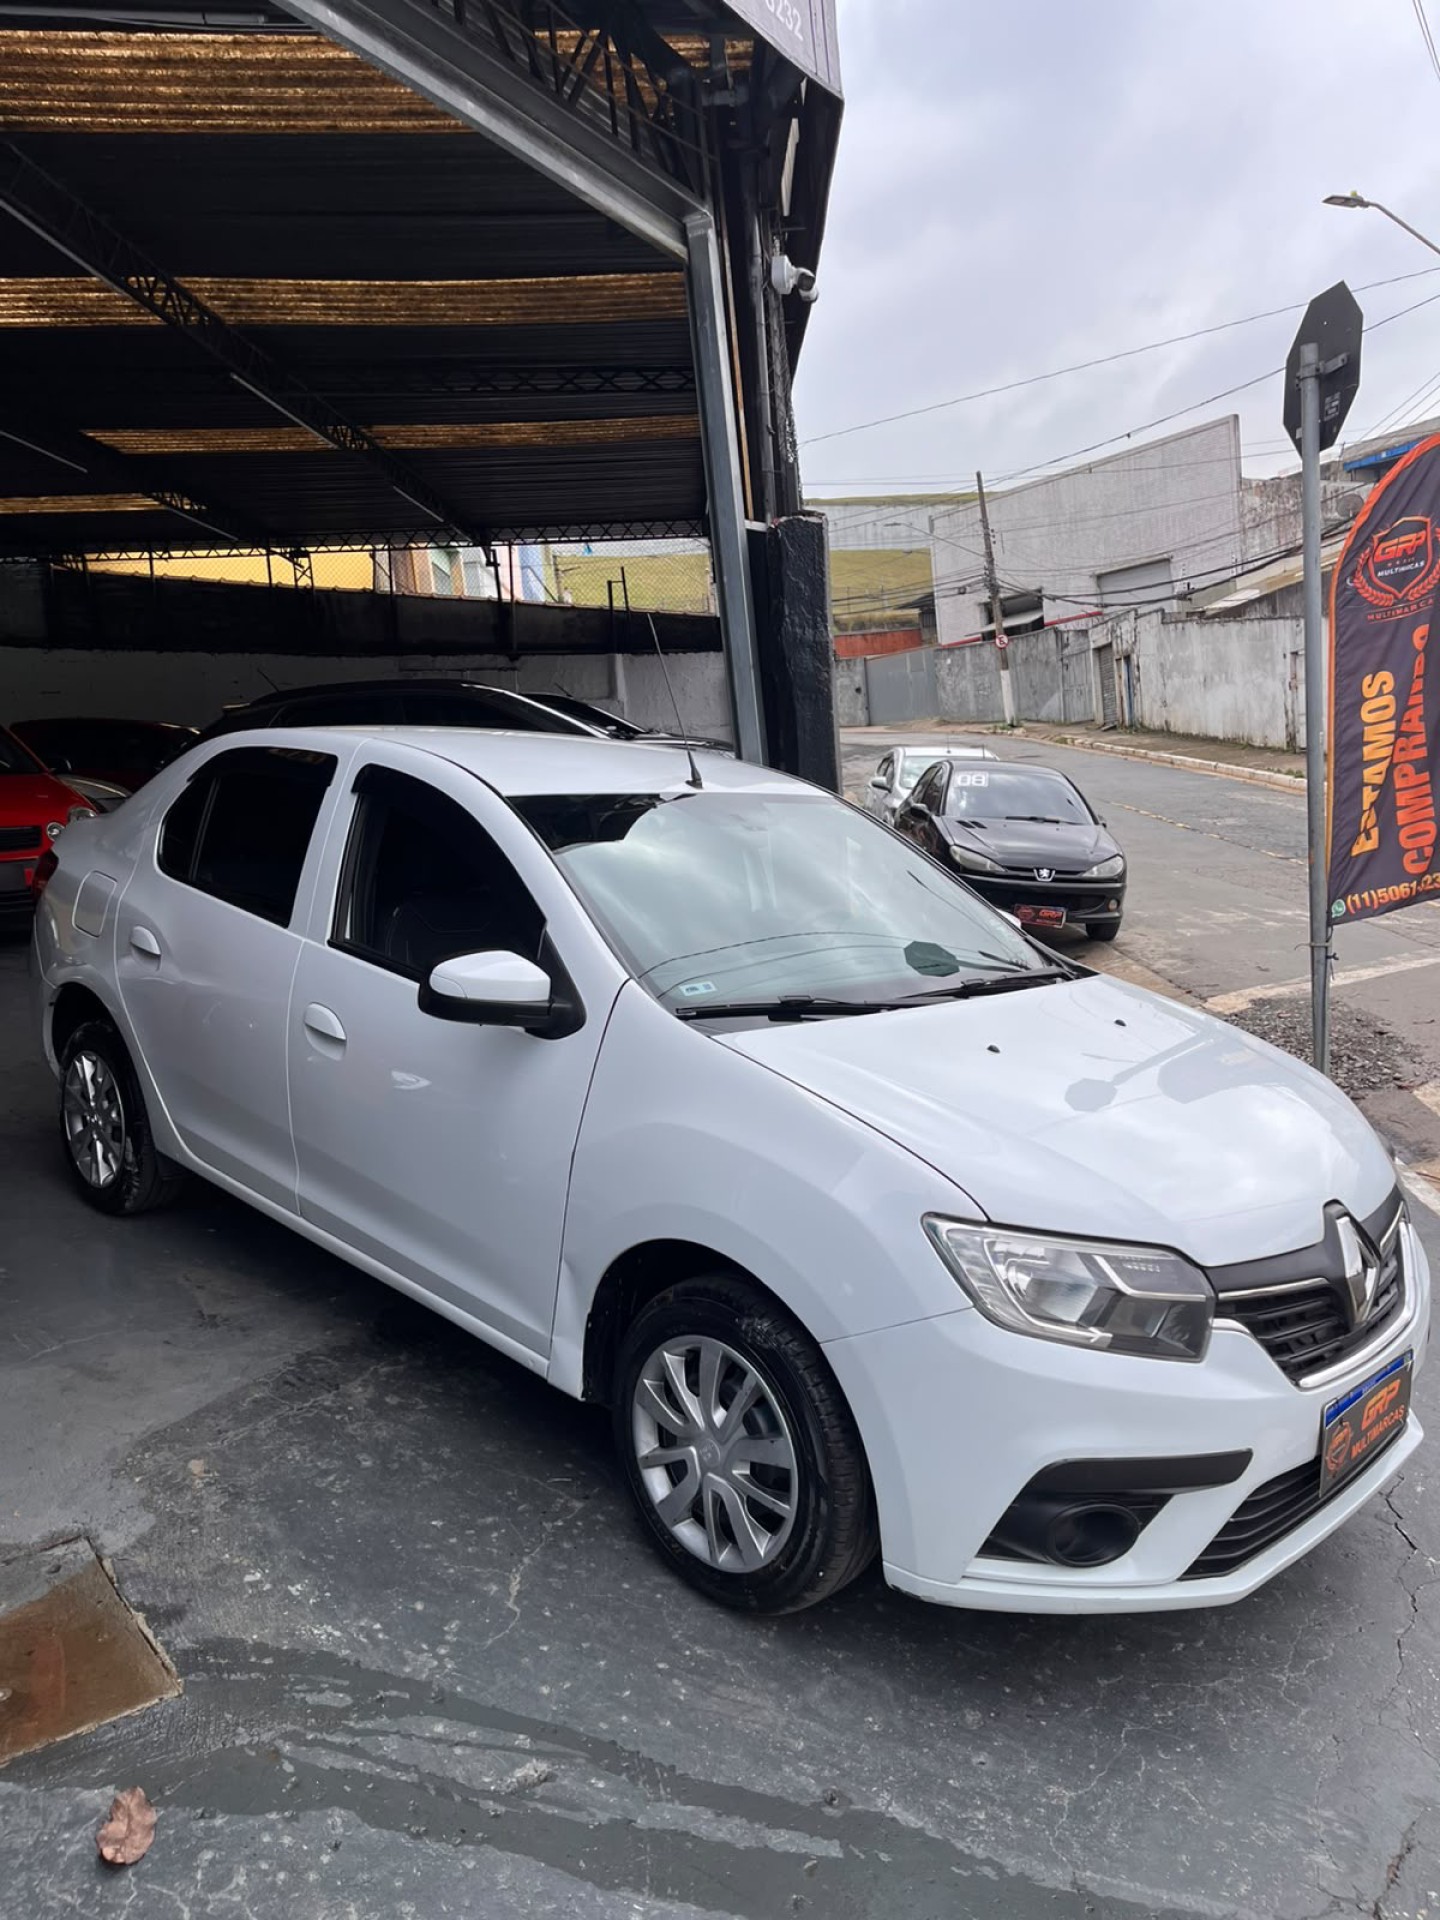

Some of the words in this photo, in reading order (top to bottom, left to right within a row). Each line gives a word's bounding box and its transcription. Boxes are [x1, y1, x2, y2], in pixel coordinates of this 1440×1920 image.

[1373, 530, 1426, 563] GRP
[1361, 1379, 1400, 1431] GRP
[1350, 1404, 1405, 1459] MULTIMARCAS
